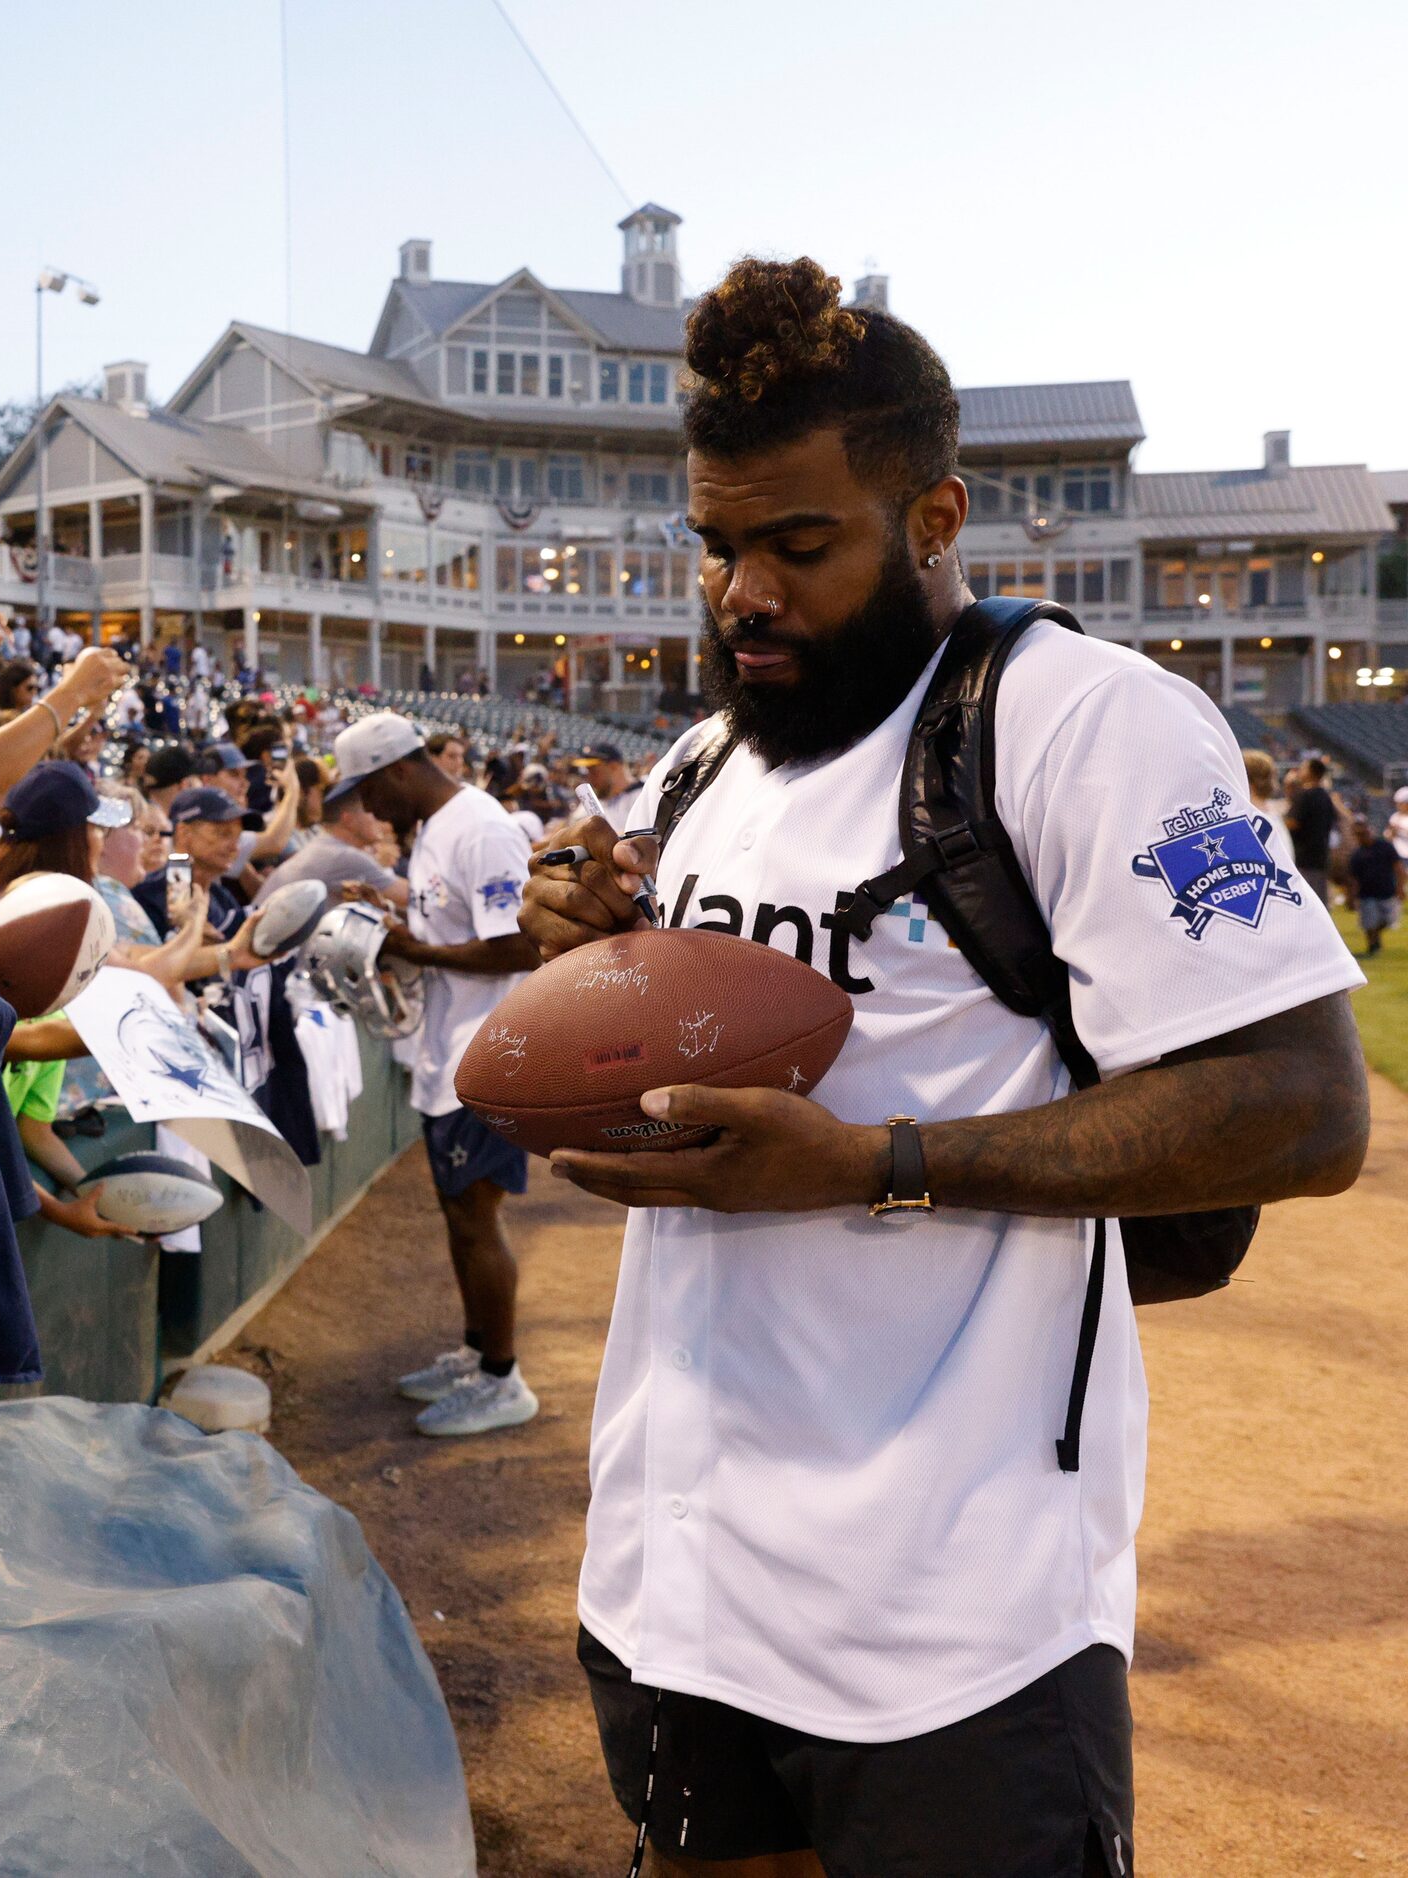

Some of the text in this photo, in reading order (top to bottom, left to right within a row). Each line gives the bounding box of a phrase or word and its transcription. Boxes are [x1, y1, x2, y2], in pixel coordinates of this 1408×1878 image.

[1162, 801, 1229, 837] reliant
[1186, 863, 1267, 900] HOME RUN
[1210, 879, 1258, 905] DERBY
